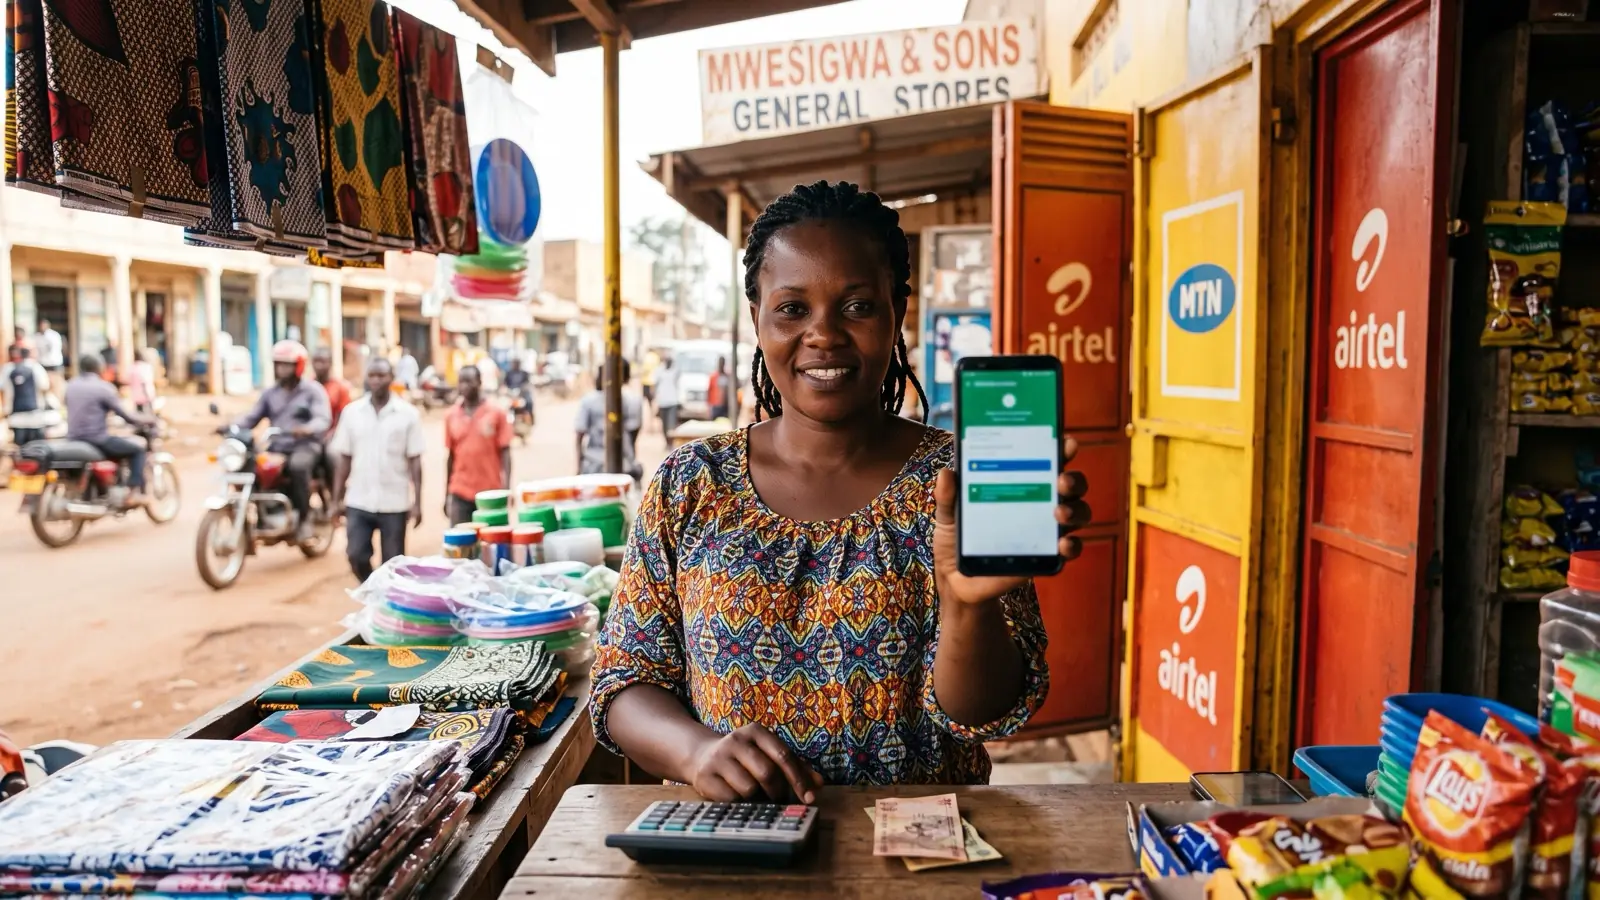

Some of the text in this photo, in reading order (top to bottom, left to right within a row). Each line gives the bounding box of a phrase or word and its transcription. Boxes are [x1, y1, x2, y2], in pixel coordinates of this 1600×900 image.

[707, 37, 892, 94] MWESIGWA
[901, 31, 921, 75] &
[933, 24, 1021, 72] SONS
[733, 89, 869, 132] GENERAL
[1179, 278, 1222, 319] MTN
[1026, 322, 1116, 364] airtel
[1333, 309, 1408, 370] airtel
[1157, 641, 1218, 726] airtel
